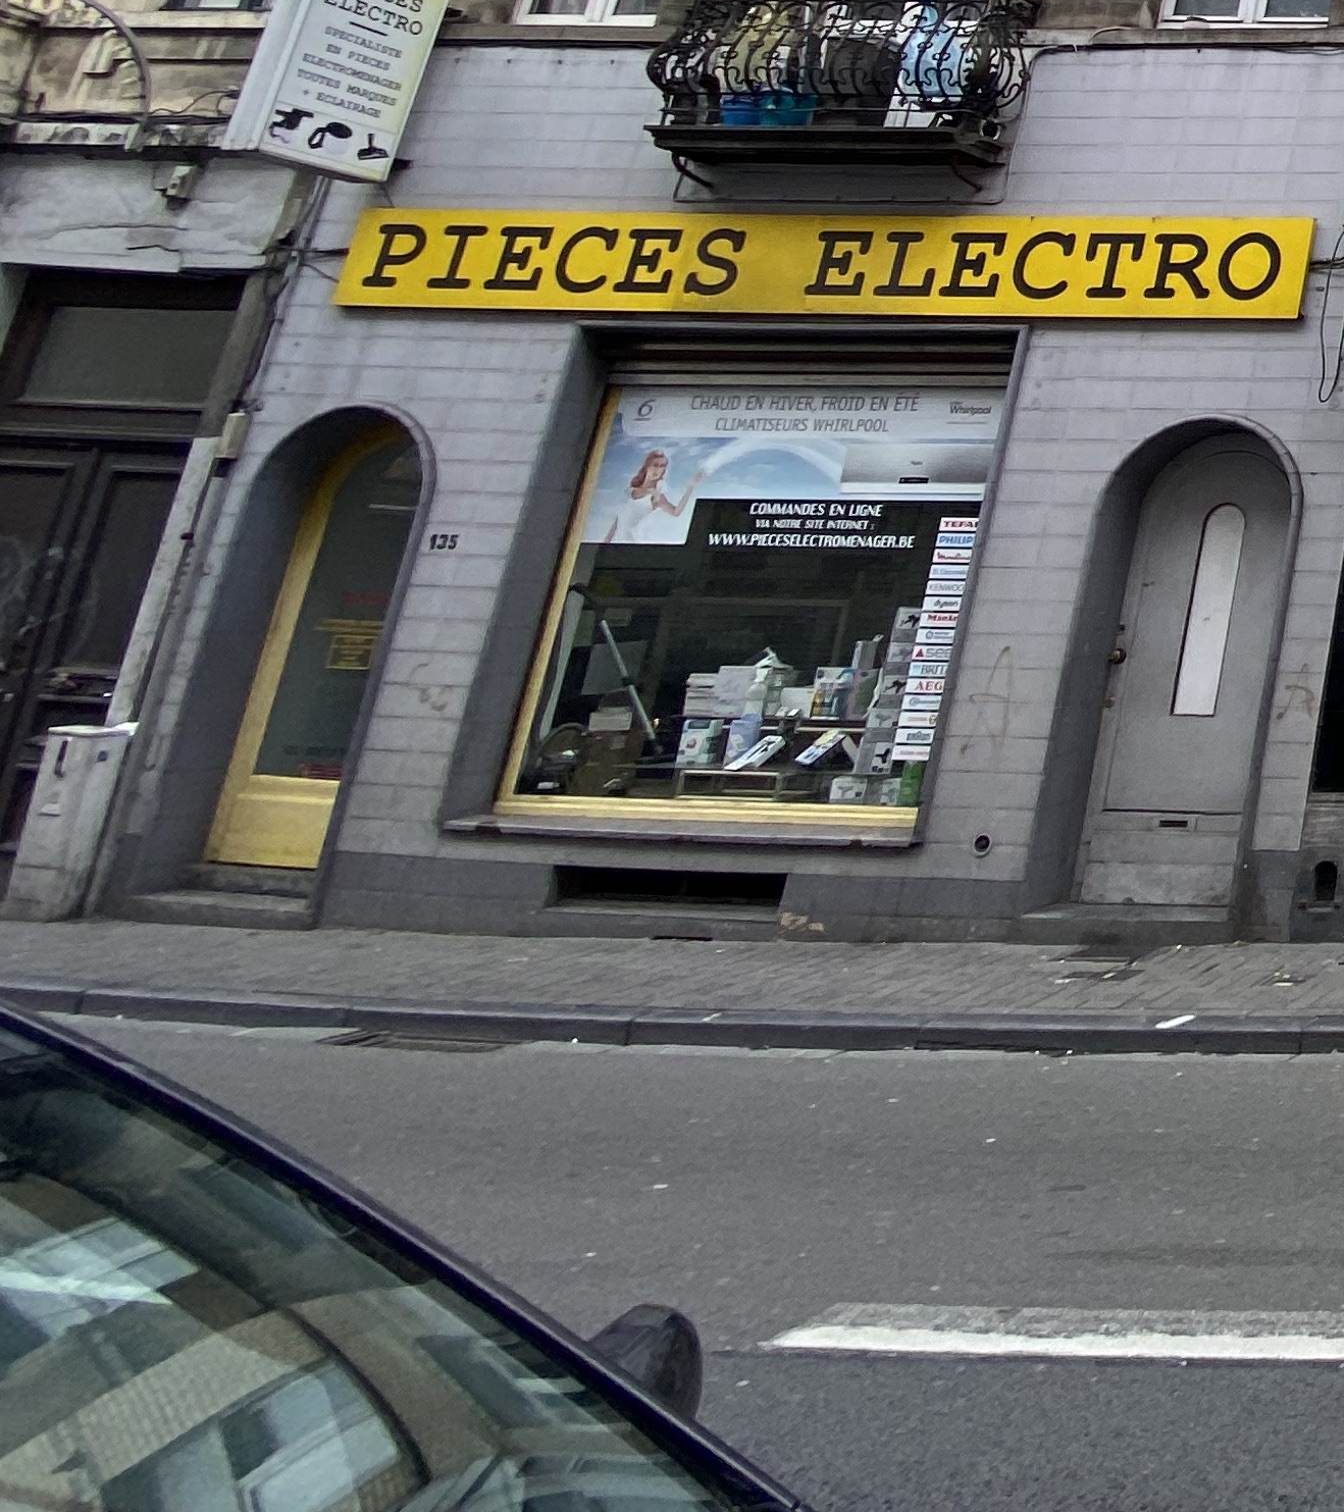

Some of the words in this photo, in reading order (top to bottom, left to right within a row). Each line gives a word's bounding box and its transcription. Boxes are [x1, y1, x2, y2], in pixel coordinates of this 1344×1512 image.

[325, 26, 402, 58] SPECIALISTE
[326, 44, 342, 55] EN
[348, 52, 390, 71] PIECES
[298, 69, 341, 89] TOUTES
[346, 83, 397, 106] MARQUES
[361, 224, 746, 295] PIECES
[804, 230, 1282, 301] ELECTRO
[690, 395, 741, 411] CHAUD
[745, 396, 763, 411] EN
[821, 396, 866, 412] FROID
[869, 396, 889, 412] EN
[893, 392, 921, 412] ÉTÉ
[949, 406, 992, 416] Whirlpool
[715, 418, 808, 432] CLIMATISEURS
[813, 418, 889, 432] WHIRLPOOL
[750, 502, 825, 517] COMMANDES
[829, 504, 846, 517] EN
[848, 504, 884, 517] LIGNE
[755, 518, 770, 529] VIA
[773, 519, 803, 529] NOTRE
[805, 519, 825, 530] SITE
[826, 519, 869, 530] INTERNET
[429, 534, 459, 550] 135
[708, 533, 915, 549] WWW.PIECESELECTROMENAGER.BE
[914, 680, 943, 691] AEG
